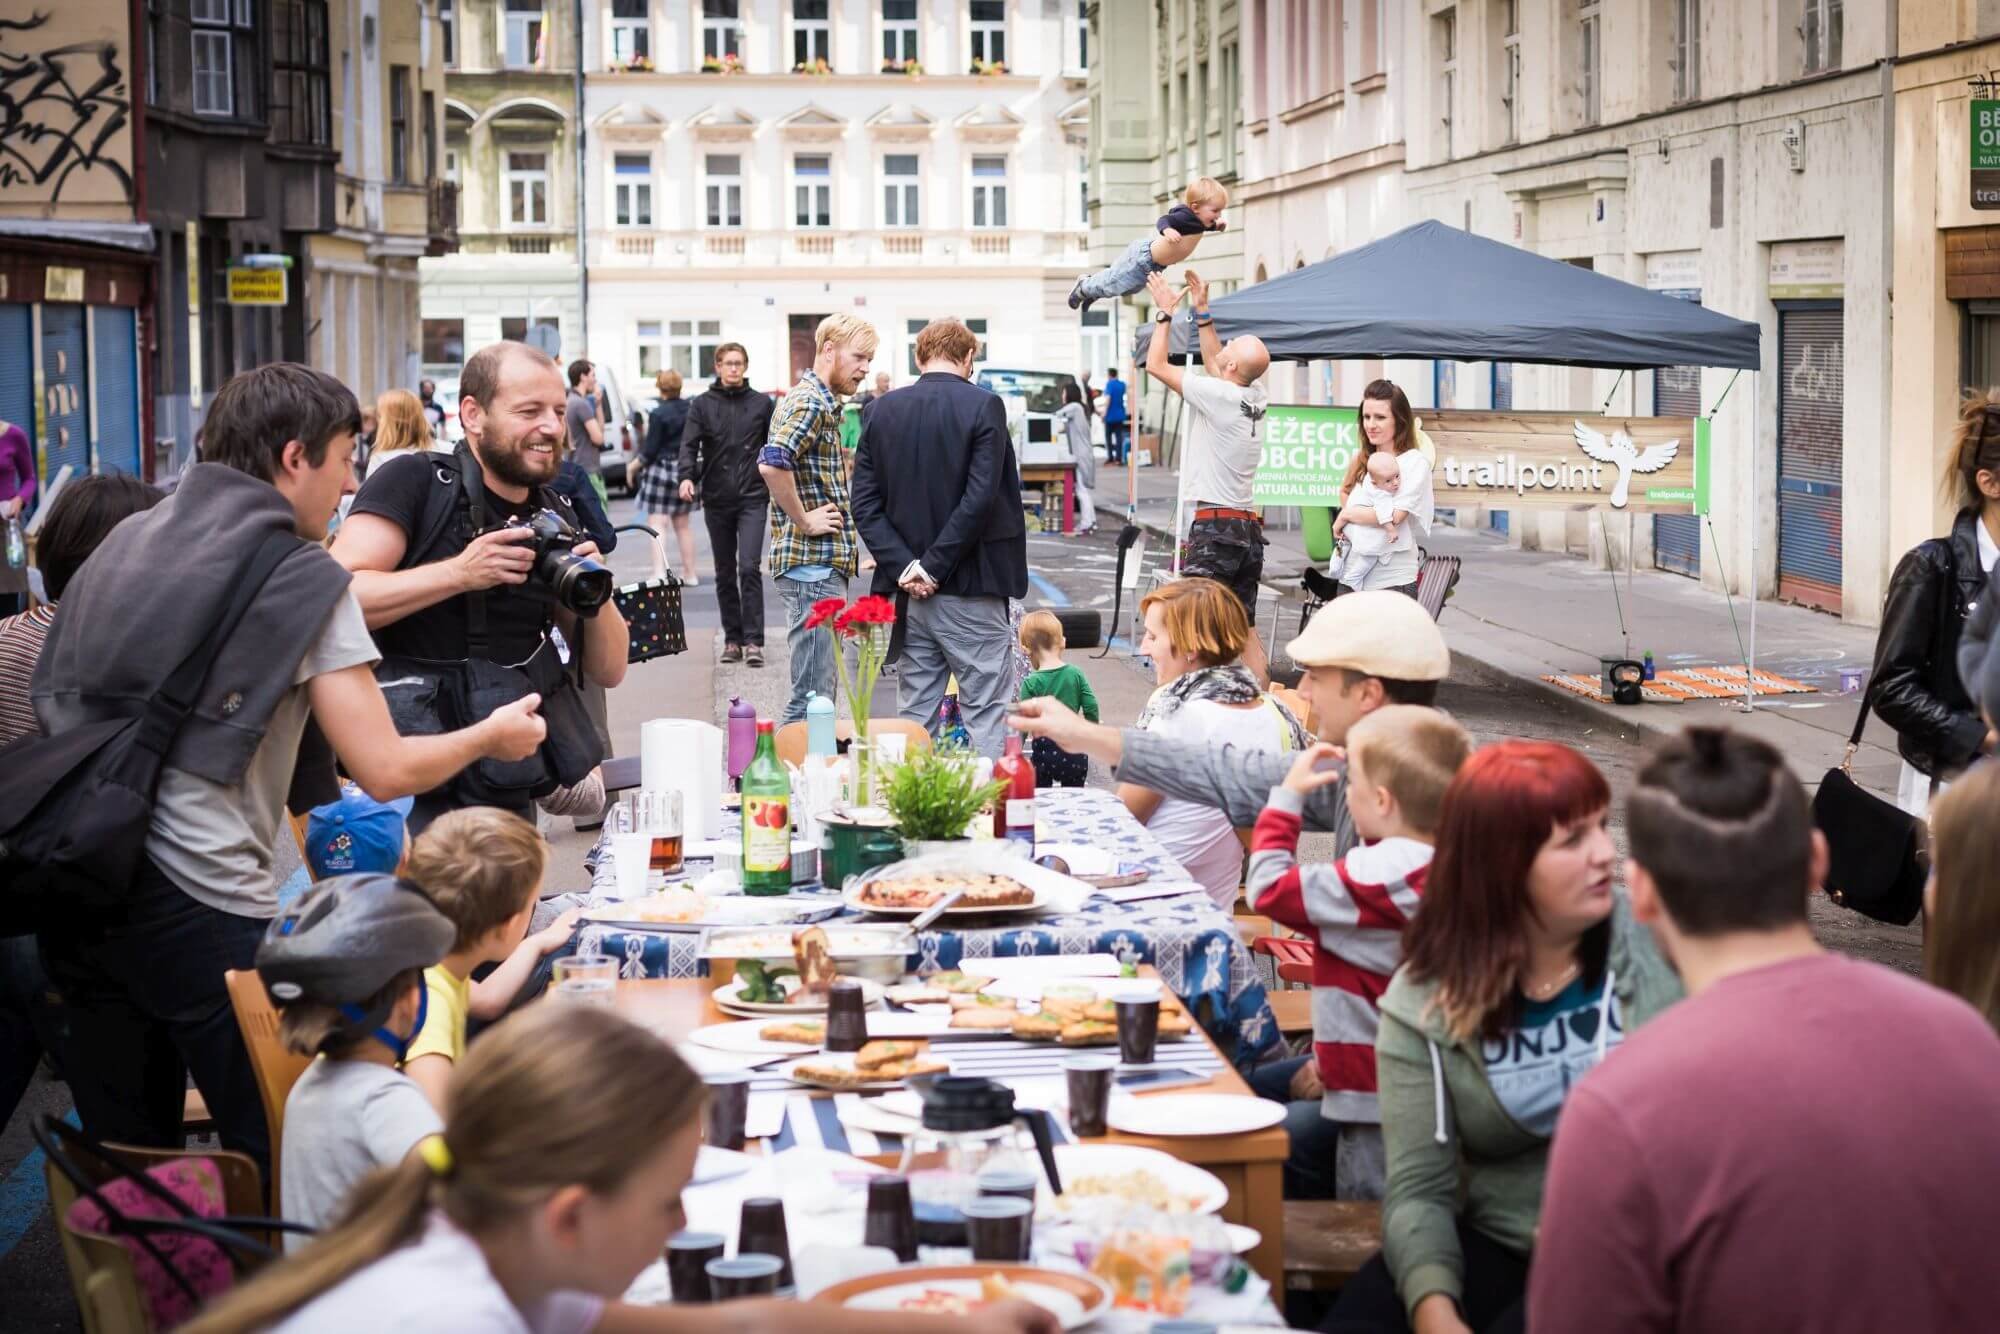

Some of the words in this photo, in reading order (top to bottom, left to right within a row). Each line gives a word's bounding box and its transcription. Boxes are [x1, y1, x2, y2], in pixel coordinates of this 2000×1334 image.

[1266, 416, 1360, 446] ĚŽECK
[1259, 446, 1361, 470] BCHO
[1443, 454, 1602, 496] trailpoint
